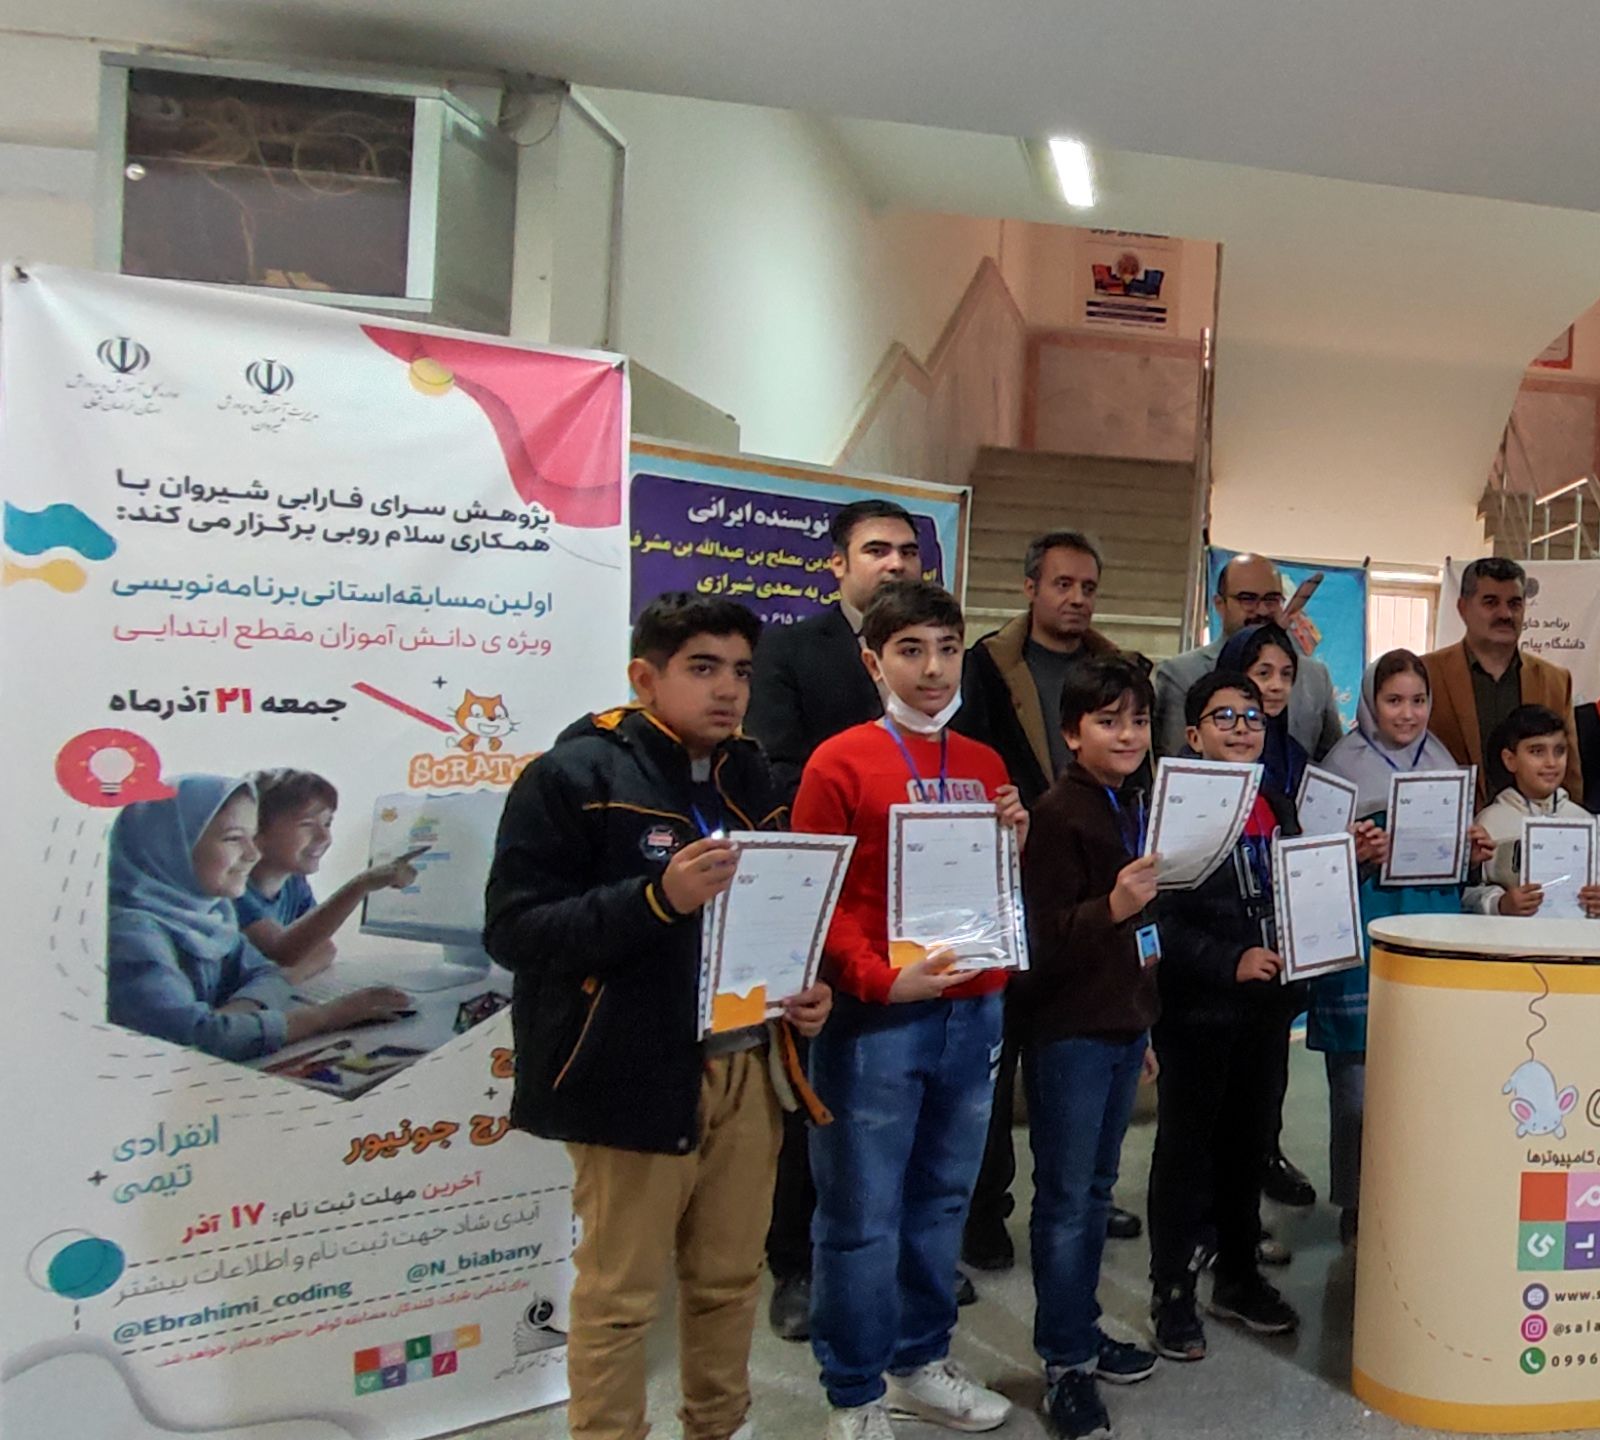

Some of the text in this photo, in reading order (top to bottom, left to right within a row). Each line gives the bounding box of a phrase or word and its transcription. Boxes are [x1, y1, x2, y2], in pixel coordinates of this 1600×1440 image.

[116, 467, 551, 535] پژوهش سرای فارابی شیروان با
[687, 495, 830, 540] نویسنده ایرانی
[116, 504, 550, 554] همکاری سلام روبی برگزار می کند:
[672, 540, 694, 558] بن
[695, 536, 745, 564] عبدالله
[745, 550, 765, 566] بن
[765, 547, 804, 568] مصلح
[111, 573, 553, 619] اولین مسابقه استانی برنامه نویسی
[696, 572, 756, 596] شیرازی
[755, 581, 803, 600] سعدی
[803, 585, 819, 601] به
[113, 613, 552, 657] ویژه ی دانش آموزان مقطع ابتدایی
[1520, 636, 1586, 654] دانشگاه پیام
[215, 687, 252, 714] ۲۱
[260, 693, 348, 722] جمعه
[410, 754, 524, 787] SCRATC
[113, 1113, 220, 1162] انفرادی
[342, 1118, 460, 1165] جونیور
[1526, 1148, 1596, 1169] کامپیوترها
[113, 1163, 193, 1204] تیمی
[181, 1170, 483, 1244] آخرین مهلت ثبت نام: ۱۷ آذر
[111, 1200, 541, 1308] آیدی شاد جهت ثبت نام و اطلاعات بیشتر
[113, 1242, 543, 1345] @Ebrahimi_coding @N_biabany
